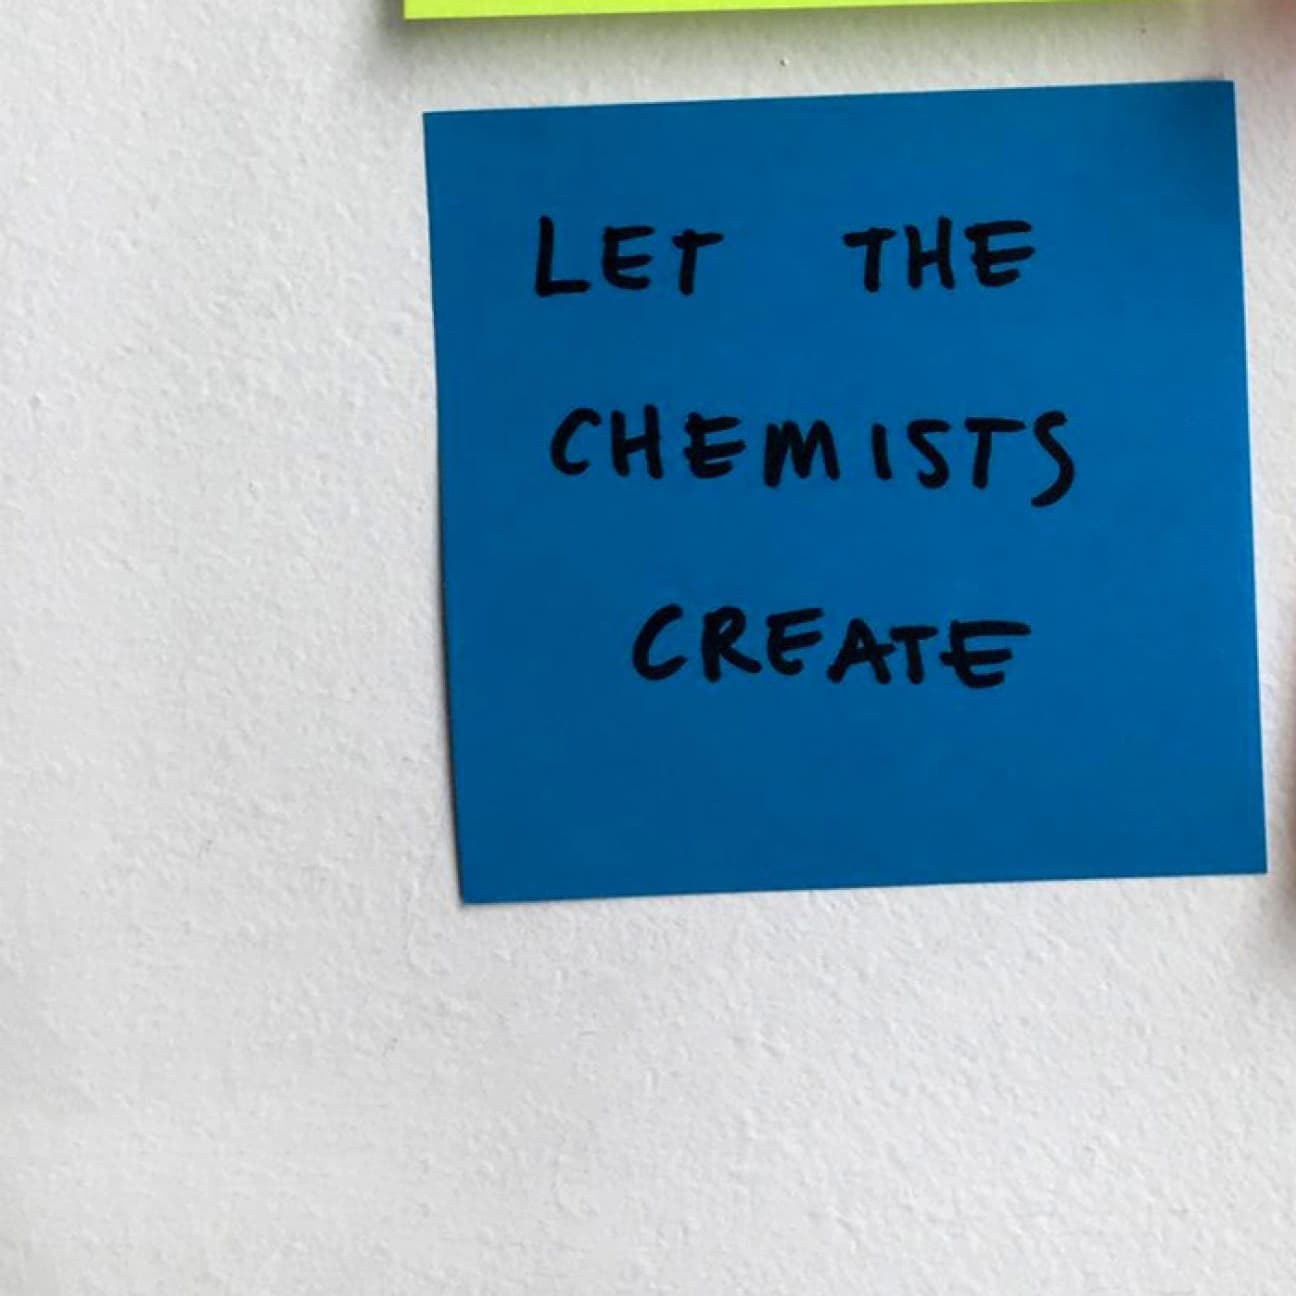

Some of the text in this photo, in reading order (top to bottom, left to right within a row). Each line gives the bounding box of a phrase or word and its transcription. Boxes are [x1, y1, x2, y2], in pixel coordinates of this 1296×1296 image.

[534, 215, 1035, 298] LET THE
[550, 404, 1075, 508] CHEMISTS
[631, 603, 1032, 689] CREATE
